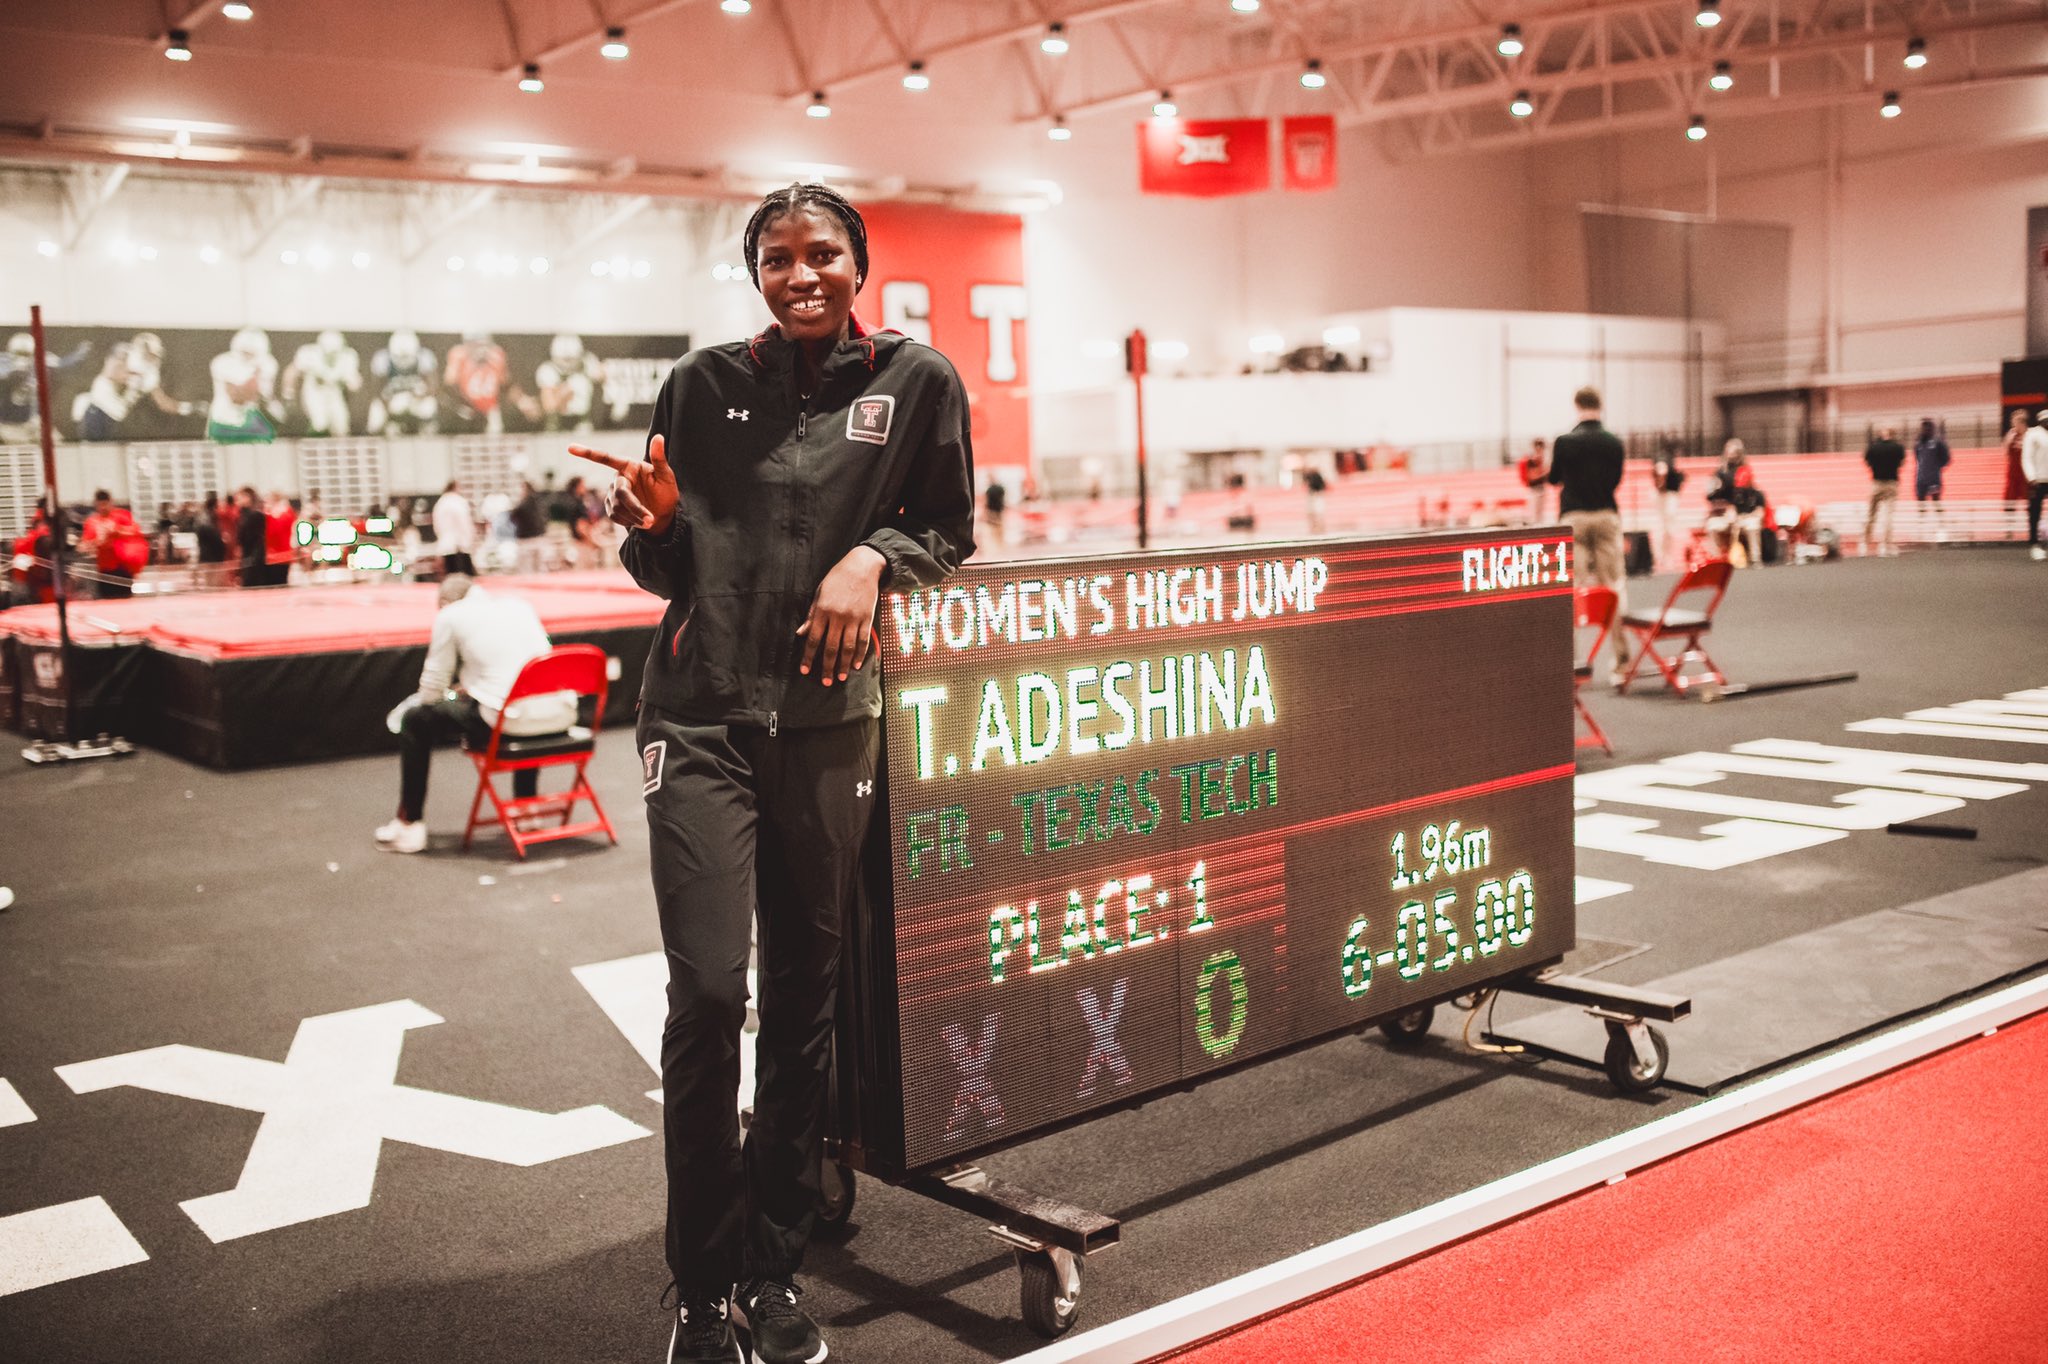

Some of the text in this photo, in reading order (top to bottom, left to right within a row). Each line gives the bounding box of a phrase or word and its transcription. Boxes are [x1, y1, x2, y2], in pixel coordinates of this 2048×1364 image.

[890, 557, 1329, 657] WOMEN'S HIGH JUMP
[1461, 541, 1570, 592] FLIGHT: 1
[906, 803, 974, 880] FR
[1012, 769, 1164, 855] TEXAS
[1170, 748, 1279, 824] TECH
[1390, 820, 1491, 890] 1.96m
[988, 860, 1215, 984] PLACE: 1
[1341, 869, 1535, 999] 6-05.00
[941, 1011, 1005, 1142] X
[1075, 976, 1134, 1099] X
